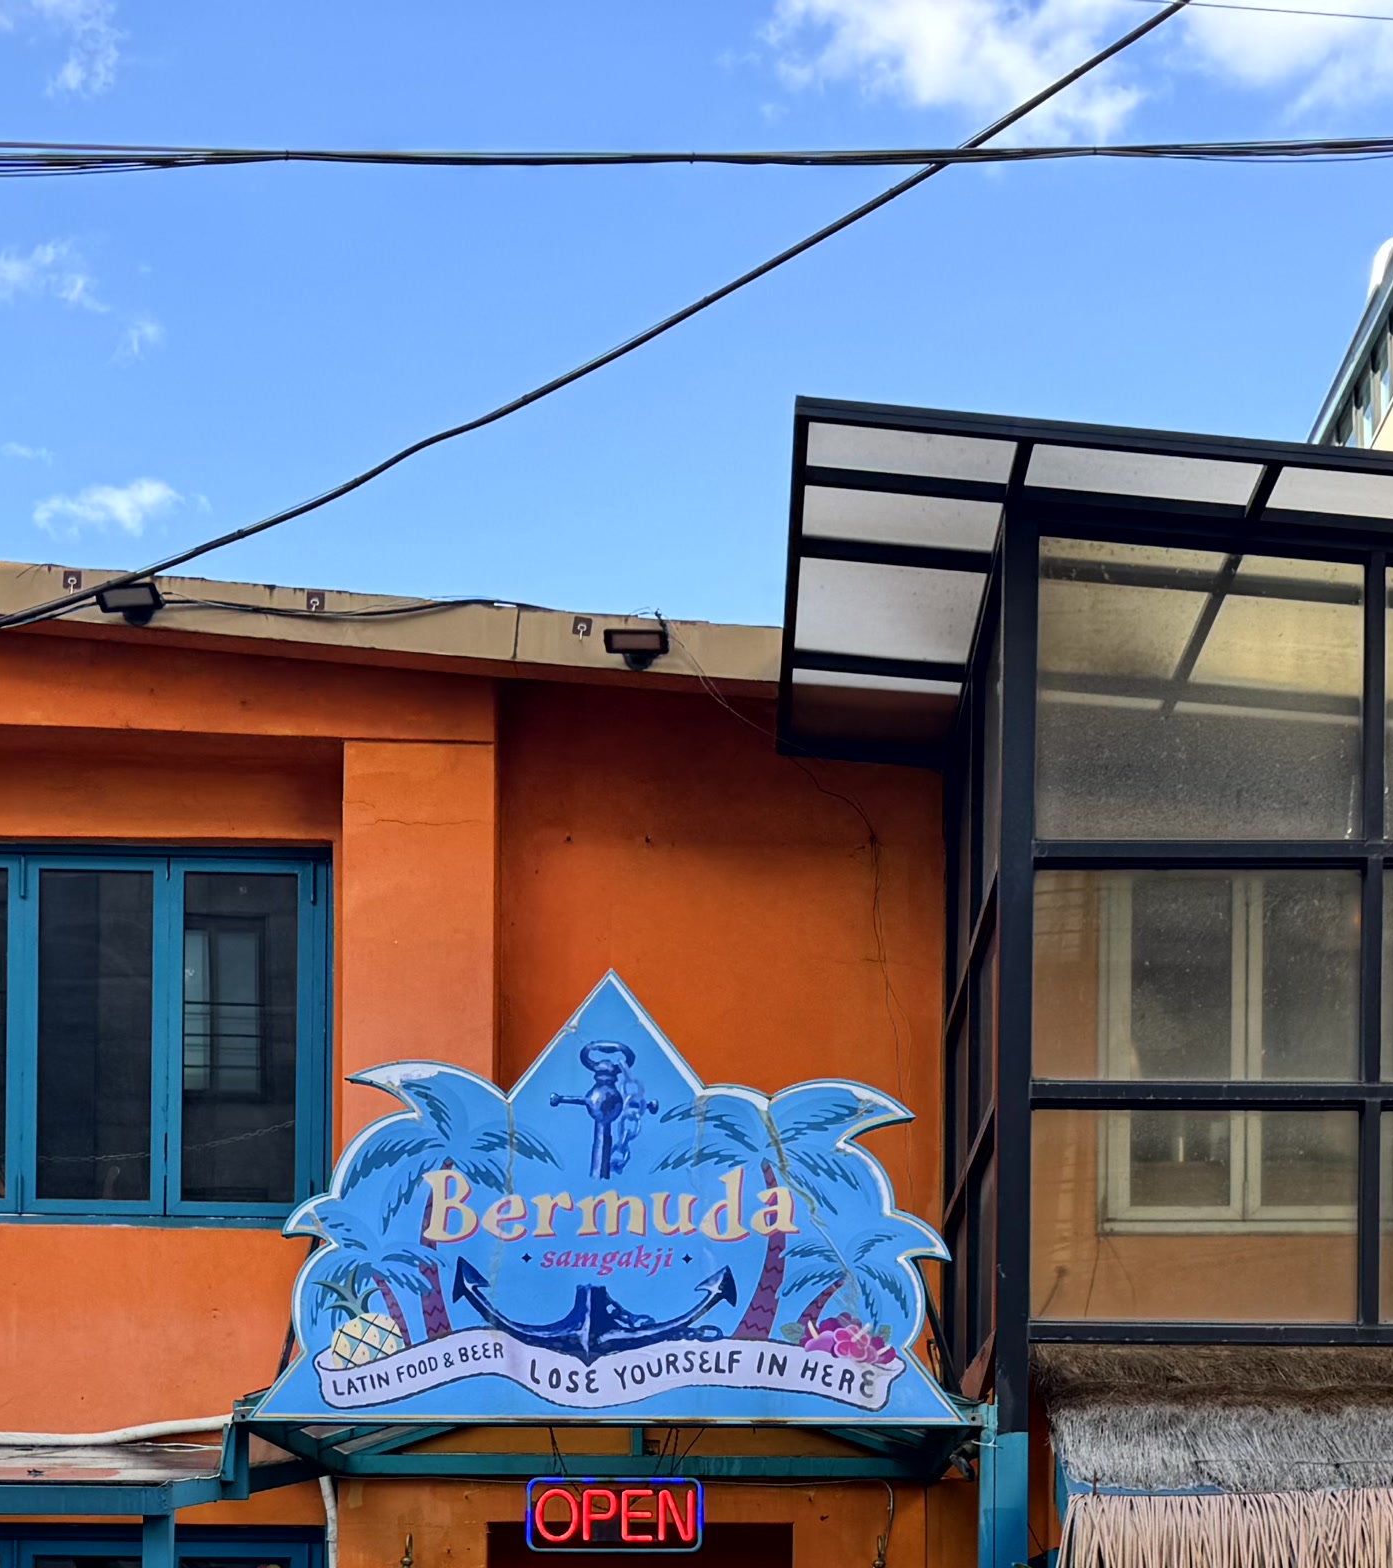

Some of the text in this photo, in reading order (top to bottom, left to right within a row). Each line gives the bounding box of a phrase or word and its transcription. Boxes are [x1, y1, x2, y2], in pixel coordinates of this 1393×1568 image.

[423, 1166, 801, 1244] Bermuda
[540, 1244, 674, 1276] samgakji
[333, 1341, 504, 1397] LATIN FOOD & BEER
[530, 1350, 877, 1399] LOSE YOURSELF IN HERE
[534, 1488, 696, 1543] OPEN
